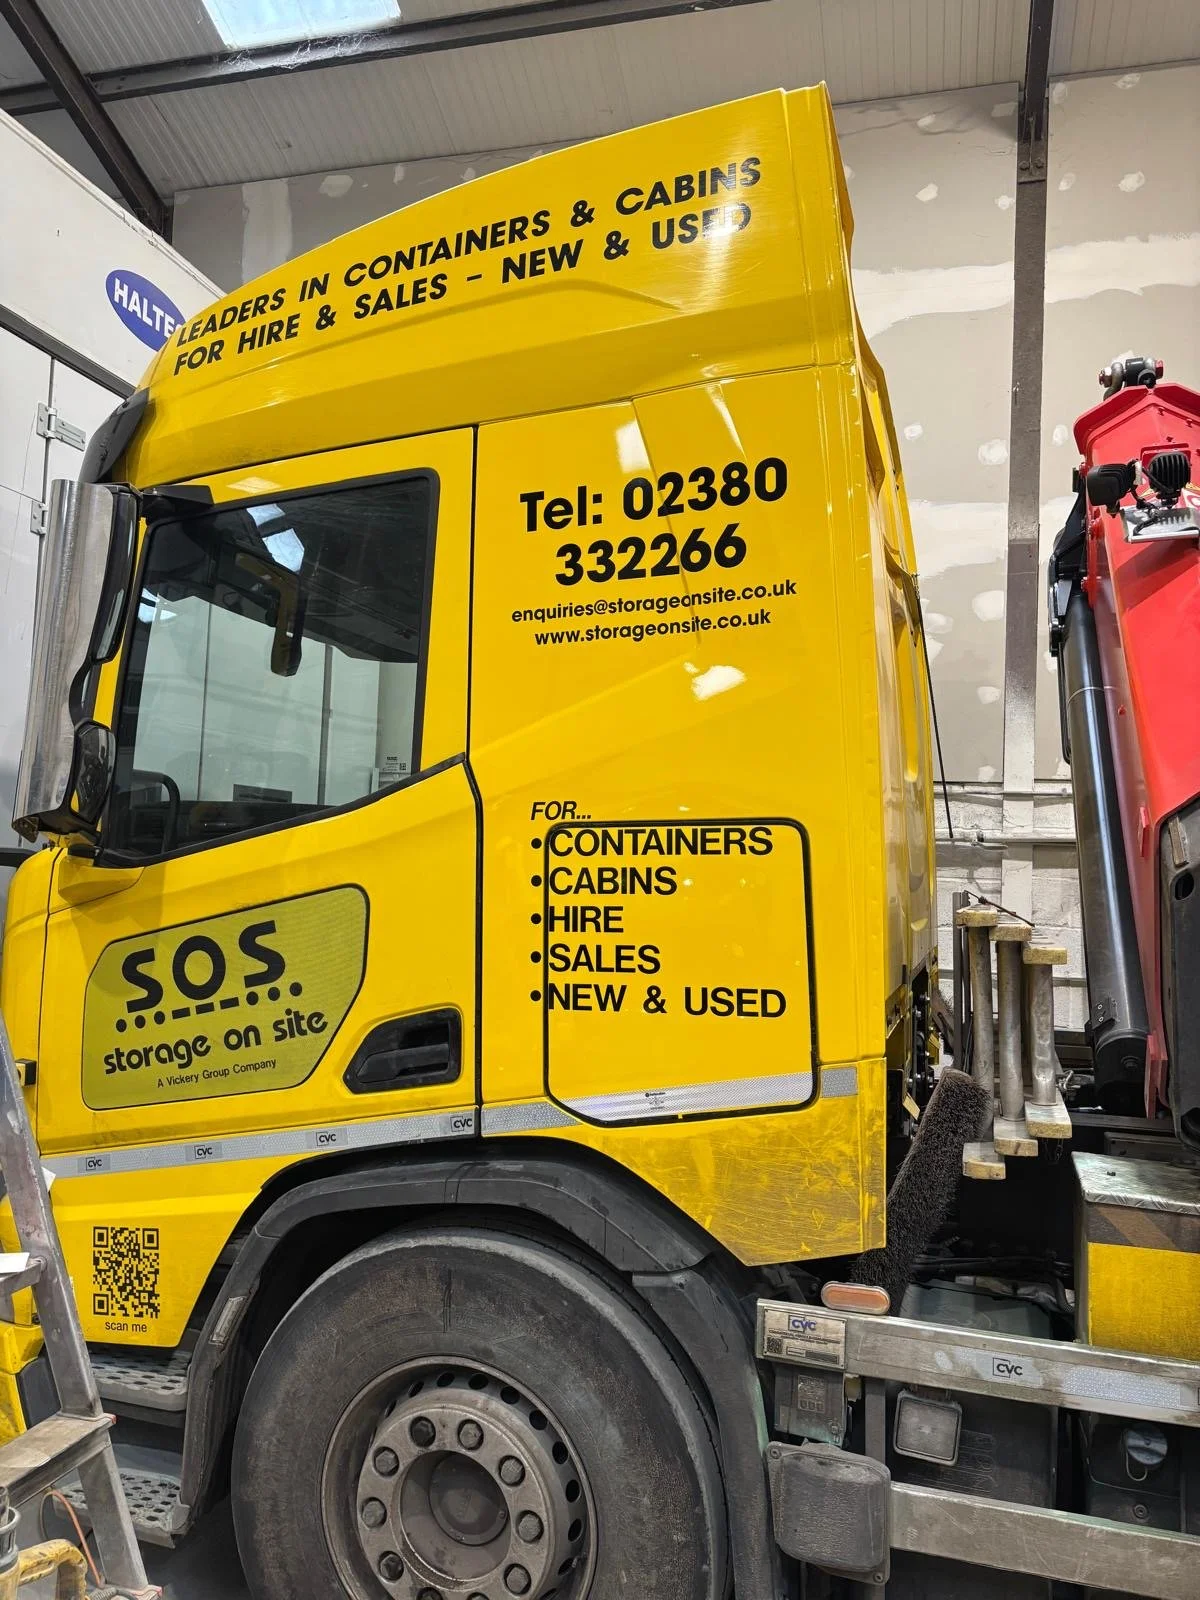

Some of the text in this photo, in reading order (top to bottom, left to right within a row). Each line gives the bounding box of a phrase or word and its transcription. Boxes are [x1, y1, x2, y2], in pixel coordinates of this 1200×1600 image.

[176, 157, 761, 347] LEADERS IN CONTAINERS & CABINS
[114, 277, 182, 338] HALTE
[173, 339, 225, 376] FOR
[237, 313, 301, 354] HIRE
[315, 304, 336, 331] &
[353, 273, 448, 320] SALES
[502, 239, 584, 284] NEW
[603, 230, 630, 260] &
[519, 457, 788, 532] Tel: 02380
[555, 522, 747, 586] 332266
[511, 579, 797, 623] enquiries@storageonsite.co.uk
[535, 609, 771, 645] www.storageonsite.co.uk
[530, 800, 592, 821] FOR...
[549, 826, 773, 857] CONTAINERS
[549, 866, 677, 895] CABINS
[548, 905, 624, 933] HIRE
[548, 943, 661, 975] SALES
[548, 982, 787, 1018] NEW & USED
[103, 1007, 328, 1075] storage on site
[157, 1058, 276, 1088] A Vickery Group Company
[317, 1133, 336, 1144] CVC
[452, 1117, 473, 1130] CVC
[87, 1158, 102, 1169] CVC
[196, 1146, 213, 1157] CVC
[105, 1321, 147, 1332] scan me
[791, 1318, 817, 1331] CVC
[996, 1362, 1023, 1376] CVC
